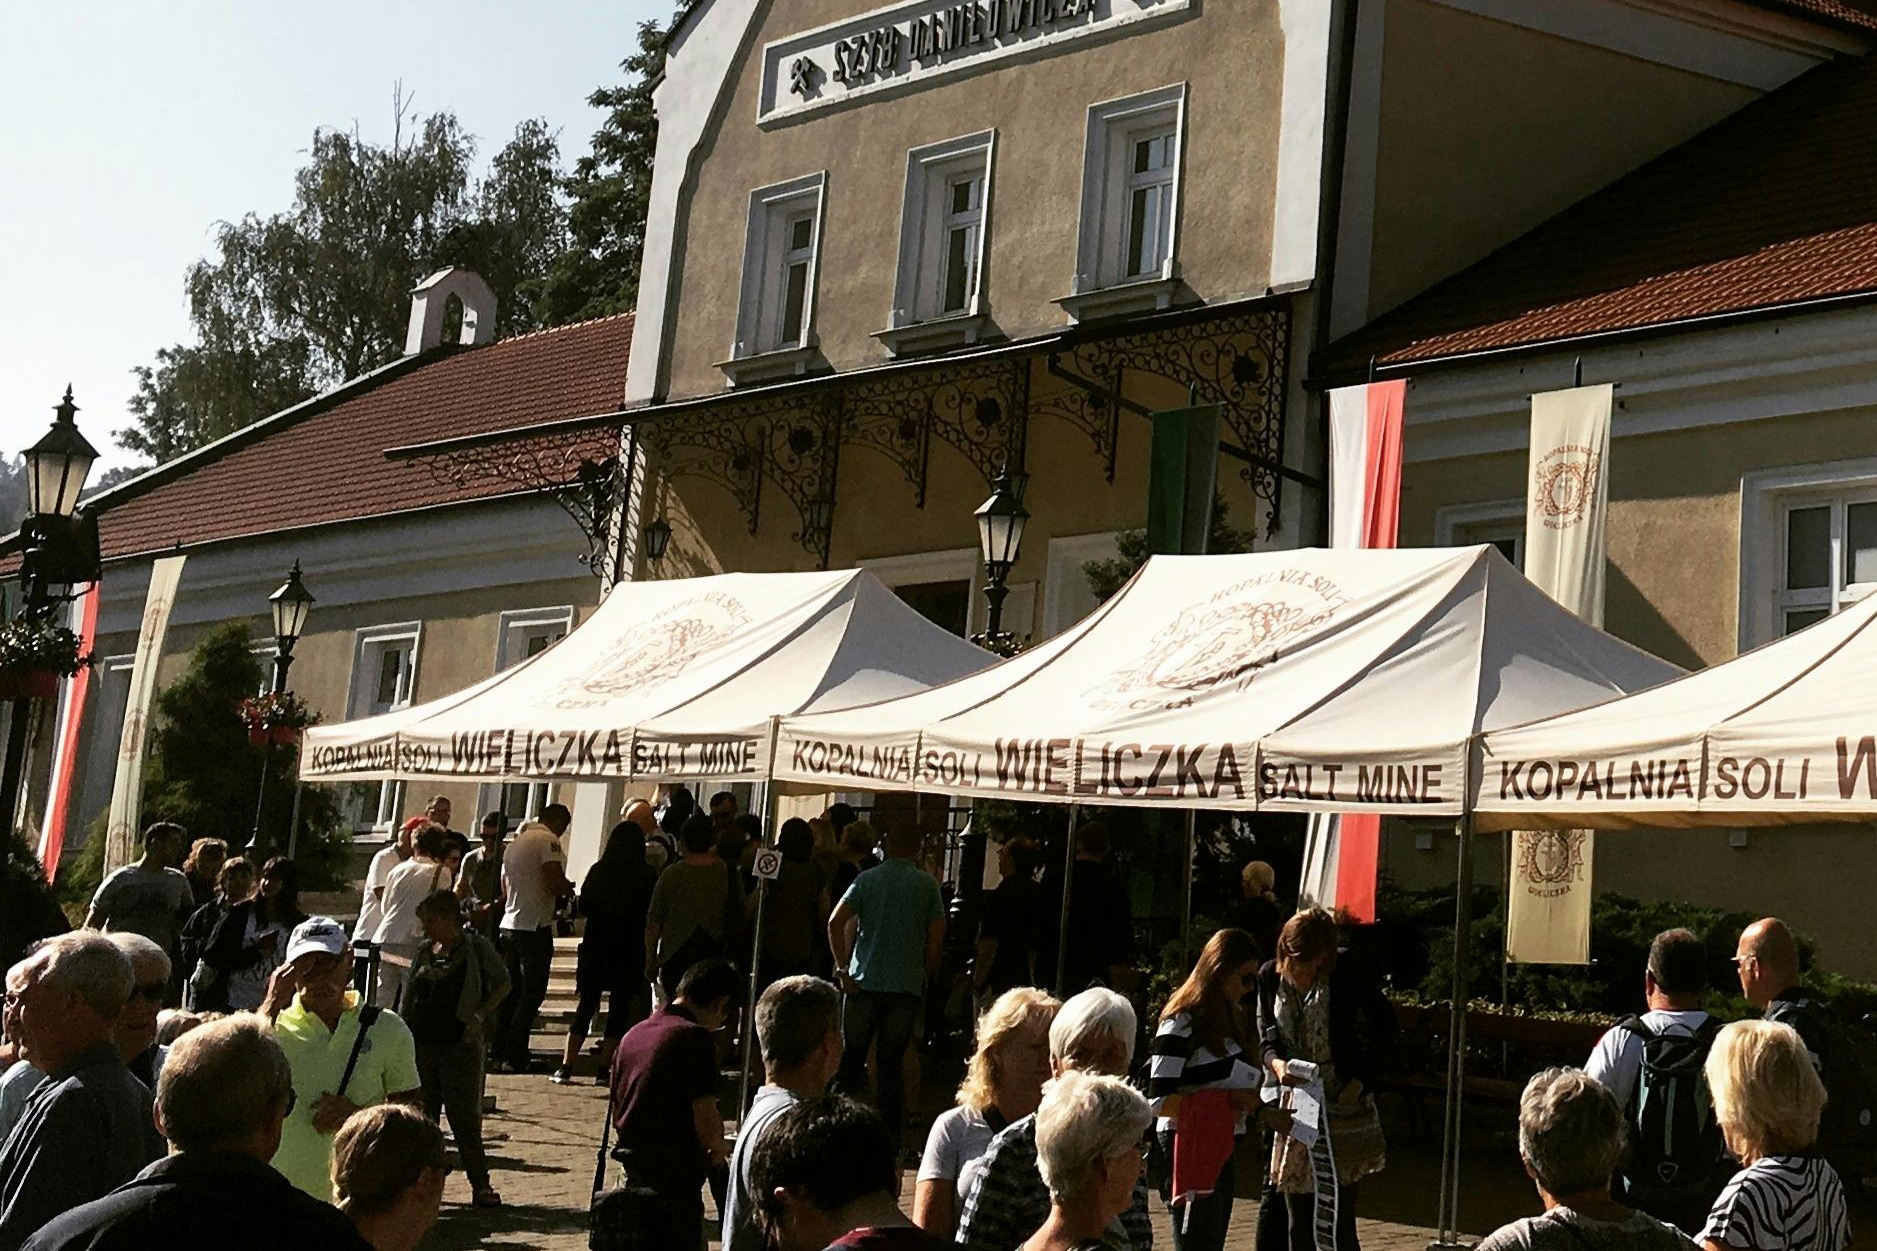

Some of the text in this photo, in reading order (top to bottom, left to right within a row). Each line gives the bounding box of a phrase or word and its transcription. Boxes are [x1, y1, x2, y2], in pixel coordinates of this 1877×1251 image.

[833, 26, 898, 82] SZYB
[1308, 575, 1338, 601] SOLI
[312, 729, 758, 774] KOPALNIA SOLI WIELICZKA SALT MINE
[792, 737, 1442, 802] KOPALNIA SOLI WIELICZKA SALT MINE
[1500, 759, 1694, 801] KOPALNIA
[1714, 756, 1809, 801] SOLI
